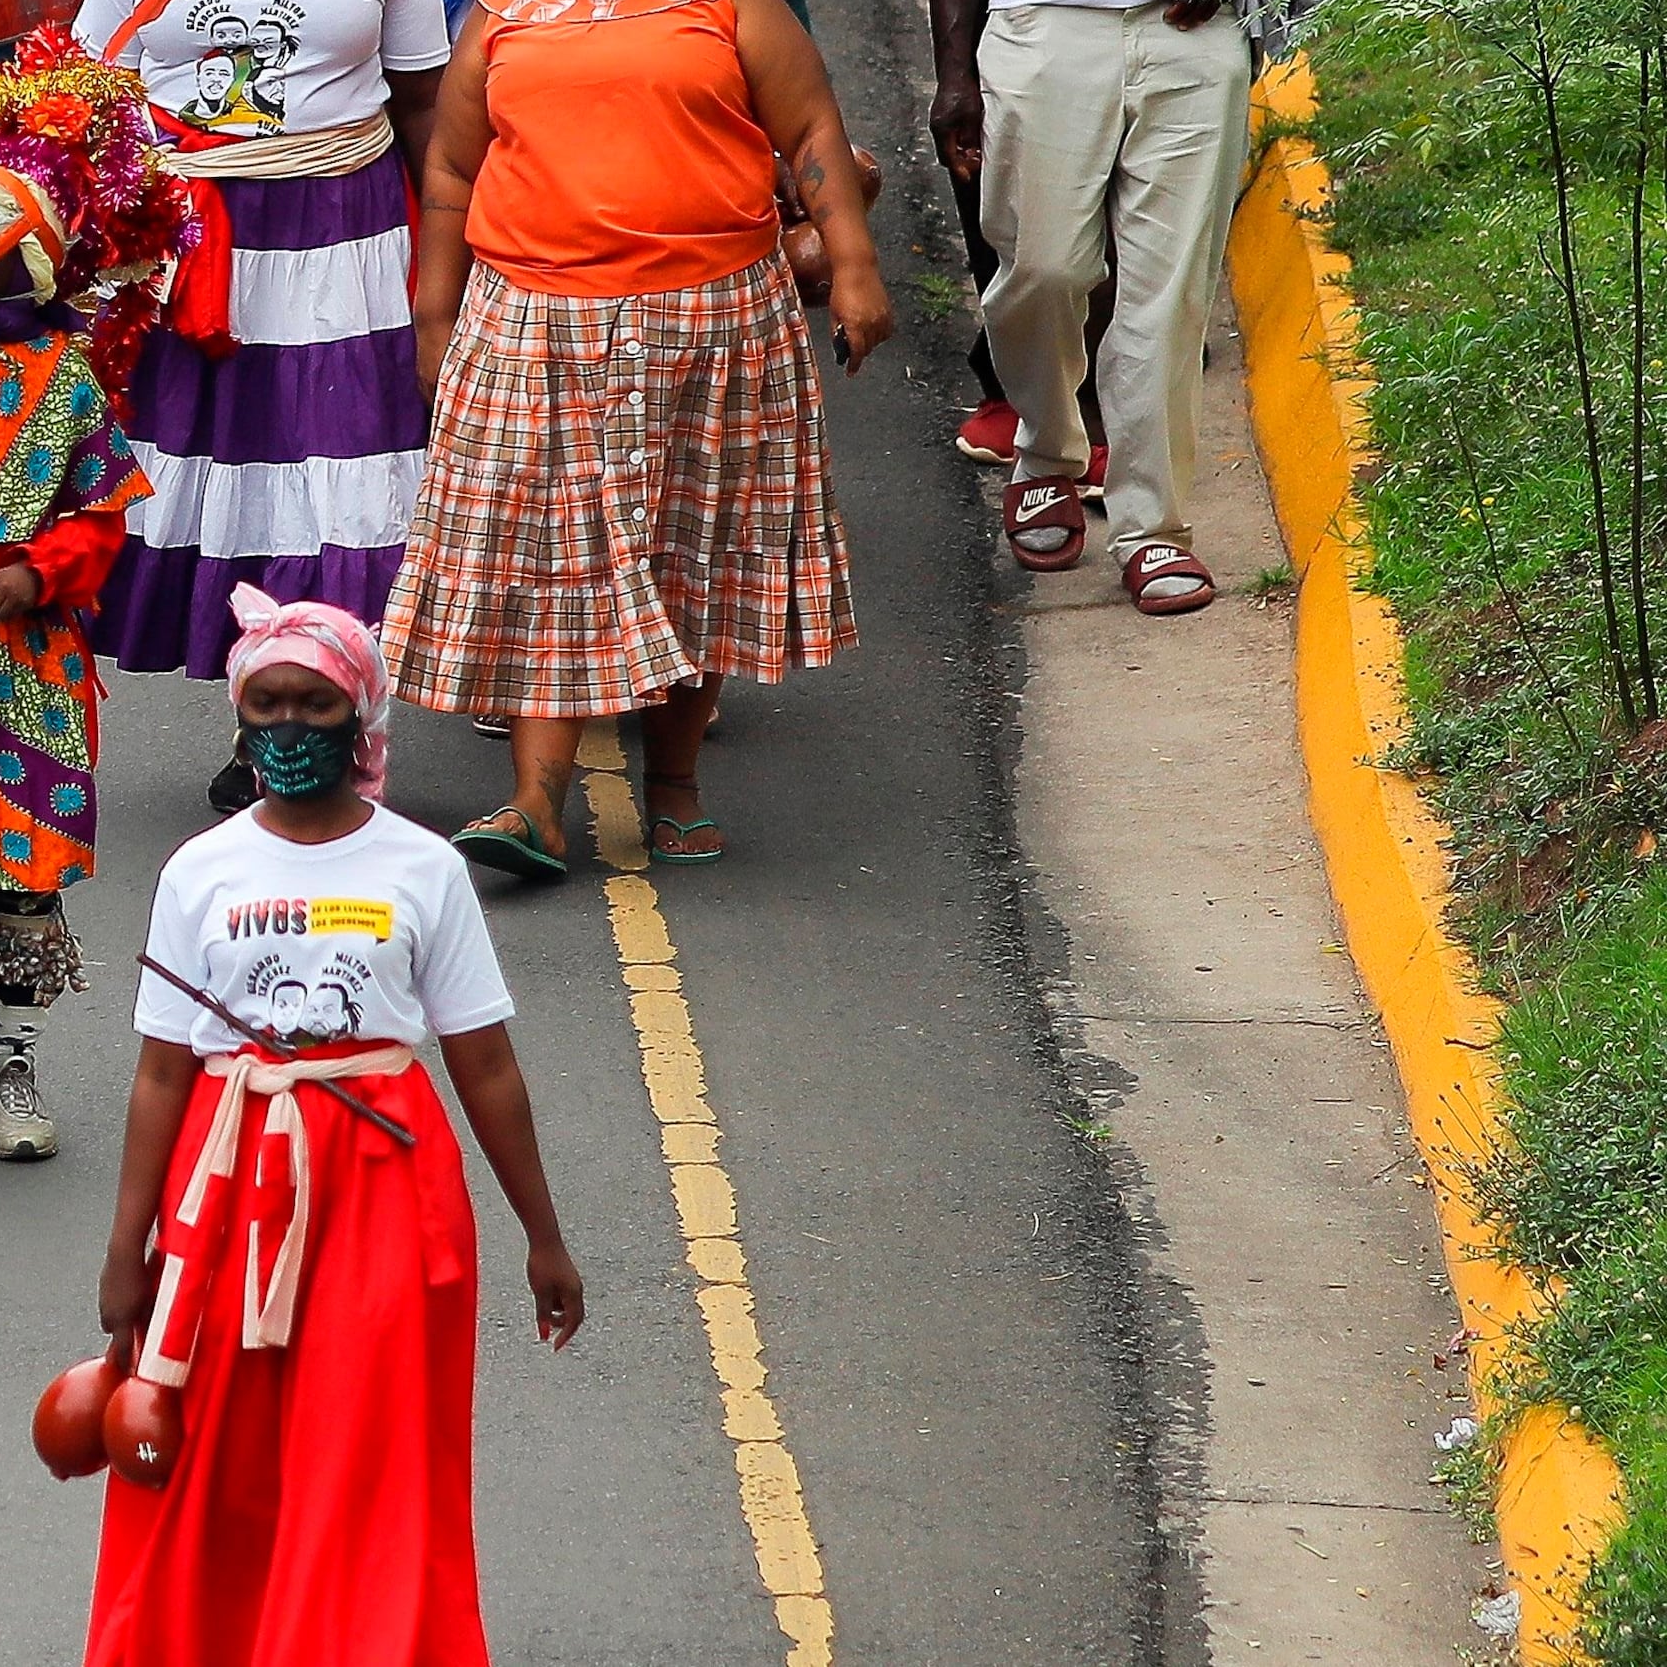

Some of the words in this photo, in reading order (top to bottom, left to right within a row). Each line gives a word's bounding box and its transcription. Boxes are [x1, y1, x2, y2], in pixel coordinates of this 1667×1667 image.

[260, 7, 300, 30] MARTINEZ
[228, 899, 307, 940] VIVOS
[335, 952, 372, 979] MILTON
